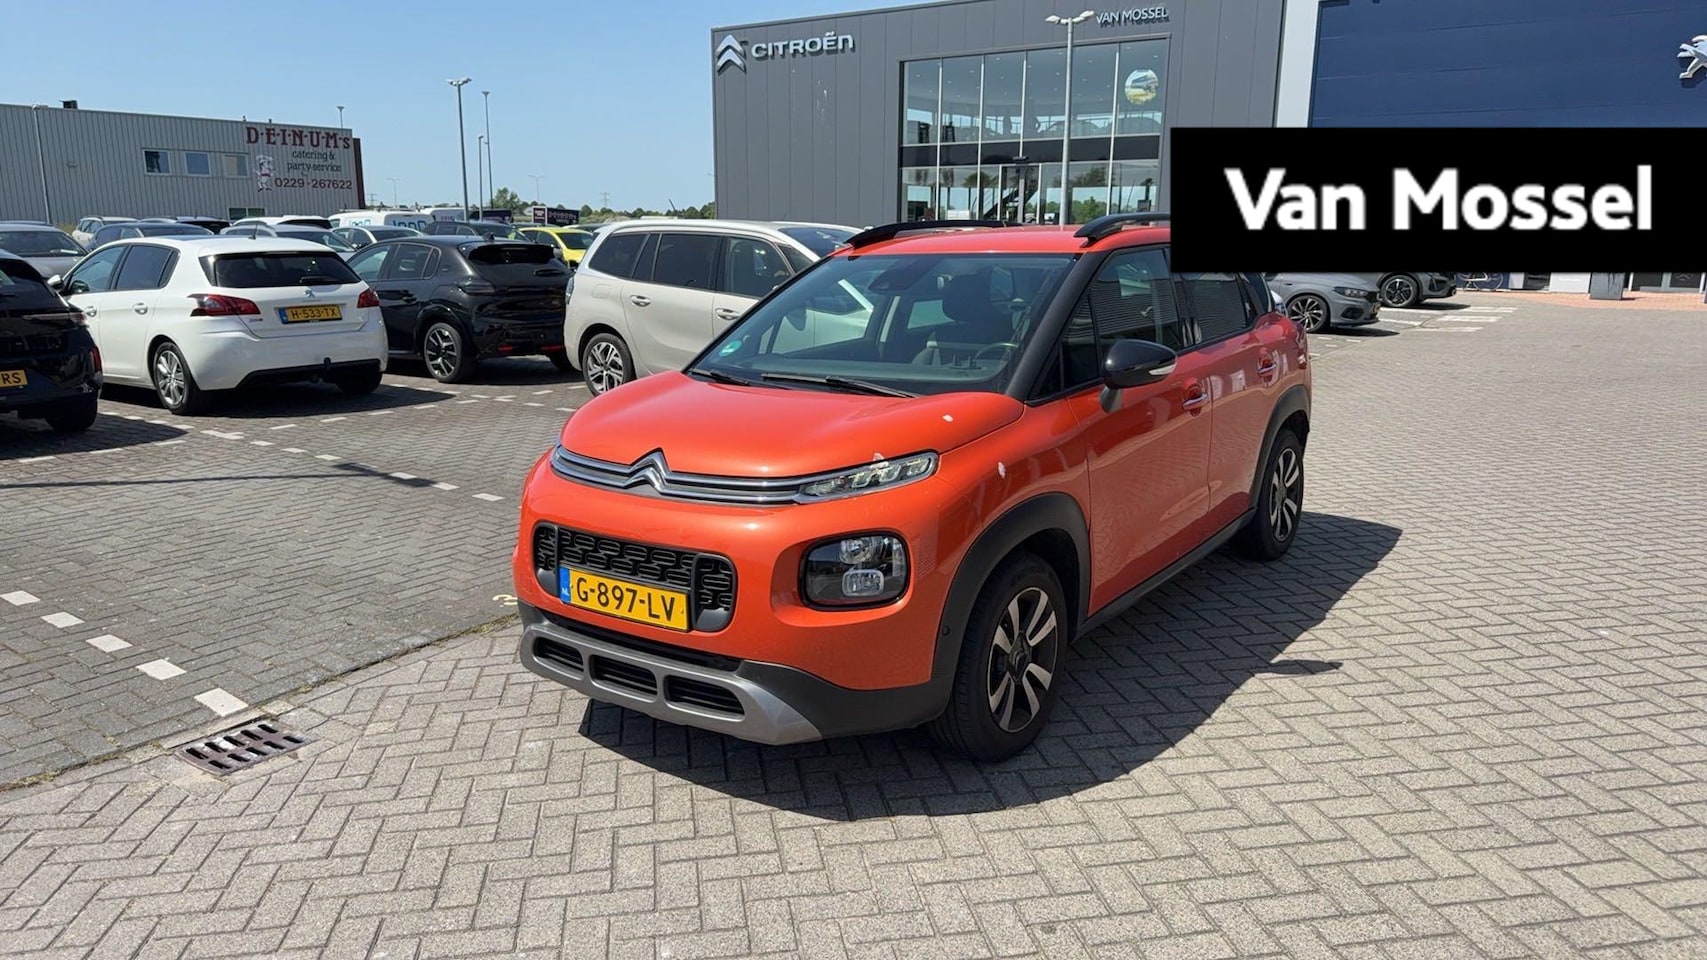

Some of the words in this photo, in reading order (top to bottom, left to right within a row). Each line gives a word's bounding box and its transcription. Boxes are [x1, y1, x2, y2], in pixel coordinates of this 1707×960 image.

[1096, 11, 1120, 24] VAN
[1122, 7, 1169, 21] MOSSEL
[751, 31, 854, 58] CITROËN
[292, 150, 328, 162] catering
[329, 151, 335, 160] &
[576, 577, 675, 622] G-897-LV
